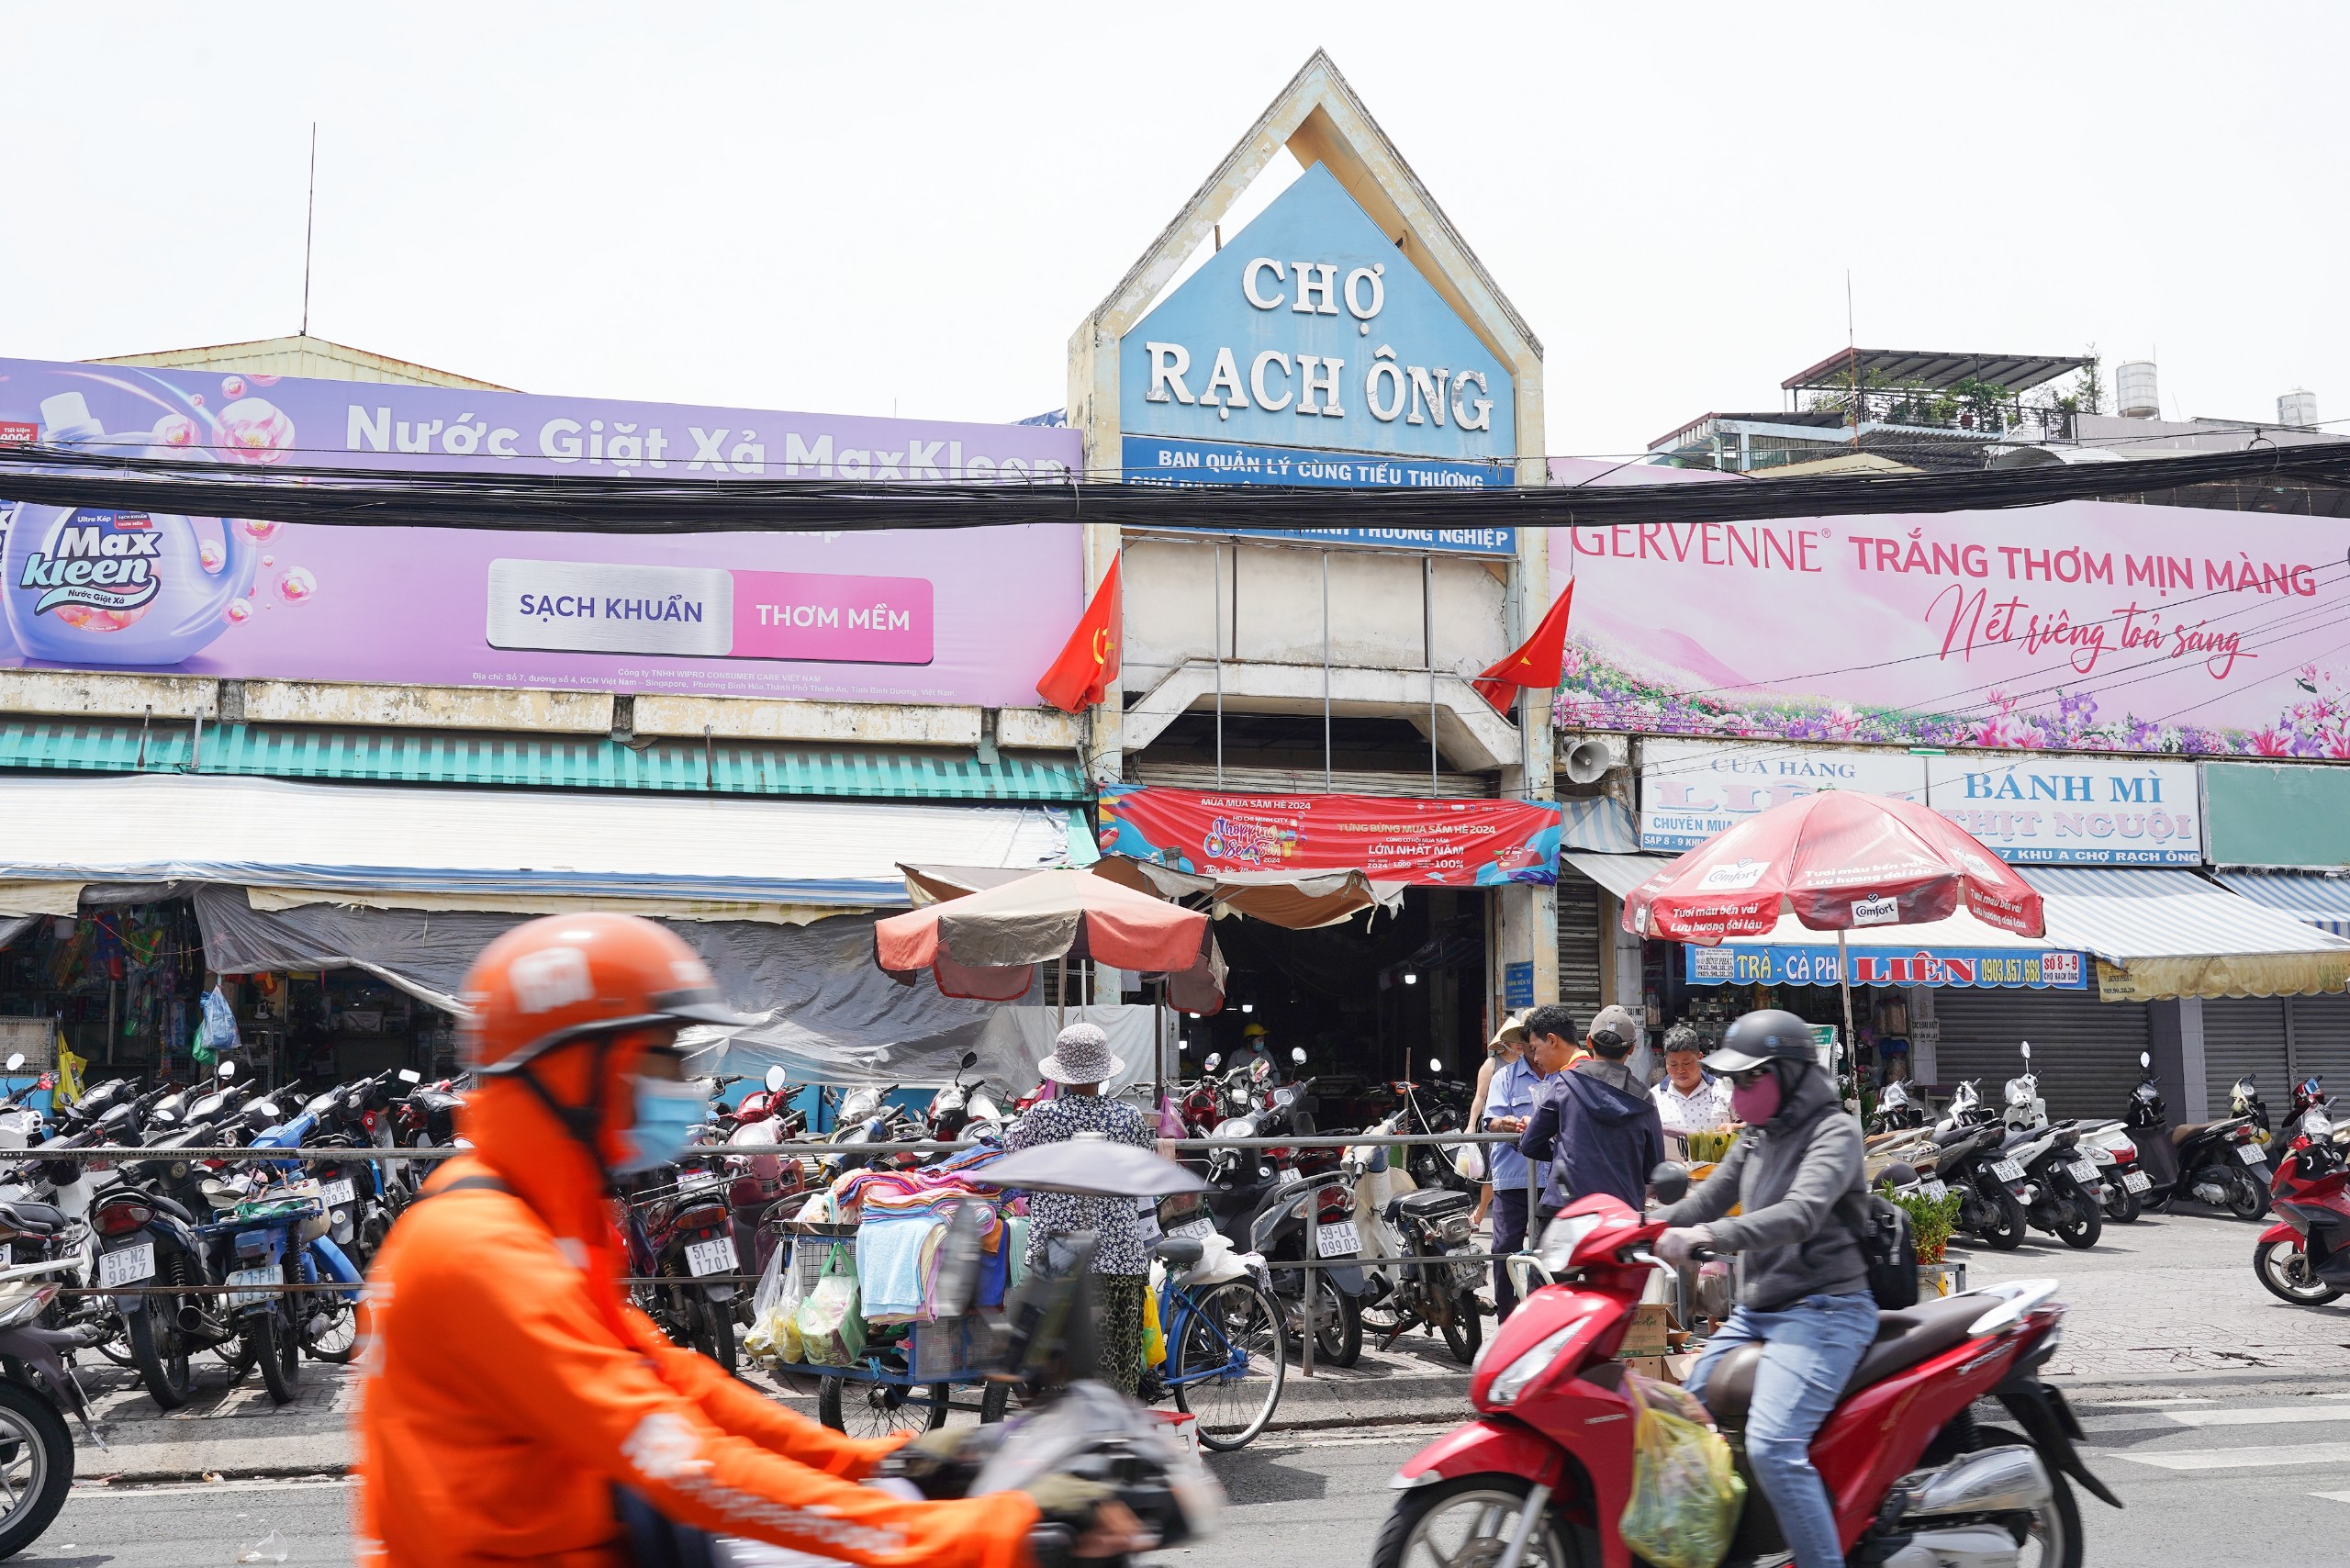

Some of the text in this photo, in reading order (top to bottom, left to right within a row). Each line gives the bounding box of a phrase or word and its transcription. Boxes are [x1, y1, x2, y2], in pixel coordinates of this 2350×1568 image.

[1242, 257, 1385, 336] CHỢ
[1146, 342, 1494, 431] RẠCH ÔNG
[346, 405, 520, 459] Nước
[538, 419, 668, 477] Giặt
[688, 427, 765, 476] Xả
[1159, 450, 1199, 467] BAN
[1206, 451, 1259, 473] QUẢN
[1267, 456, 1291, 476] LÝ
[1298, 459, 1351, 481] CÙNG
[1407, 469, 1483, 490] THƯƠNG
[96, 515, 112, 524] Kép
[57, 527, 162, 558] Max
[1438, 528, 1508, 549] NGHIỆP
[21, 553, 150, 586] kleen
[1848, 530, 1987, 577] TRẮNG
[1998, 545, 2114, 586] THƠM
[2126, 554, 2193, 597] MỊN
[2204, 558, 2316, 597] MÀNG
[68, 589, 125, 605] Nước Giặt Xả
[520, 593, 911, 632] SẠCH KHUẨN THƠM MỀM
[1925, 583, 2029, 662] Nét
[2020, 608, 2119, 675] riêng
[2172, 622, 2258, 680] sáng
[472, 673, 487, 681] Địa
[506, 672, 518, 681] Số
[528, 675, 557, 685] đường
[558, 675, 568, 683] số
[619, 678, 637, 686] Nam
[728, 681, 746, 689] Bình
[618, 668, 639, 678] Công
[642, 670, 650, 678] ty
[651, 669, 675, 678] TNHH
[677, 670, 705, 678] WIPRO
[707, 671, 755, 680] CONSUMER
[757, 673, 779, 681] CARE
[1711, 754, 1856, 778] CỬA HÀNG
[1963, 765, 2165, 803] BÁNH MÌ
[1202, 798, 1224, 806] MÙA
[1274, 799, 1286, 809] HÈ
[1402, 825, 1427, 834] MUA
[1454, 823, 1468, 834] HÈ
[1470, 826, 1496, 834] 2024
[1652, 815, 1733, 832] CHUYÊN MUA
[1941, 807, 2192, 844] THỊT NGUỘI
[1204, 816, 1280, 857] Shopping
[1664, 837, 1670, 846] 8
[1368, 842, 1464, 855] LỚN NHẤT NĂM
[2001, 849, 2200, 864] 7 KHU A CHỢ RẠCH ÔNG
[1435, 859, 1464, 868] 100%
[1708, 868, 1759, 883] Comfort
[1673, 908, 1695, 918] Tươi
[1855, 903, 1895, 918] Comfort
[1670, 922, 1691, 933] Lưu
[1693, 921, 1724, 933] hương
[1737, 948, 1772, 979] TRÀ
[1786, 949, 1809, 980] CÀ
[1815, 957, 1839, 980] PH
[1853, 951, 1977, 983] LIÊN
[1981, 958, 2040, 983] 0903.857.668
[2043, 955, 2077, 970] SỐ 8 9
[2043, 971, 2078, 983] CHỢ RẠCH ÔNG
[1996, 1160, 2016, 1173] 59-L3
[2071, 1162, 2091, 1173] 95-H1
[2075, 1169, 2099, 1182] 640.12
[2125, 1172, 2143, 1183] 59-C2
[326, 1191, 352, 1204] 89.31
[1319, 1224, 1353, 1241] 59-LA
[692, 1239, 727, 1260] 51-T3
[1321, 1238, 1360, 1255] 099.03
[108, 1248, 146, 1270] 51-N2
[697, 1254, 730, 1274] 1701
[108, 1263, 146, 1285] 9827
[237, 1268, 275, 1285] 71-FH
